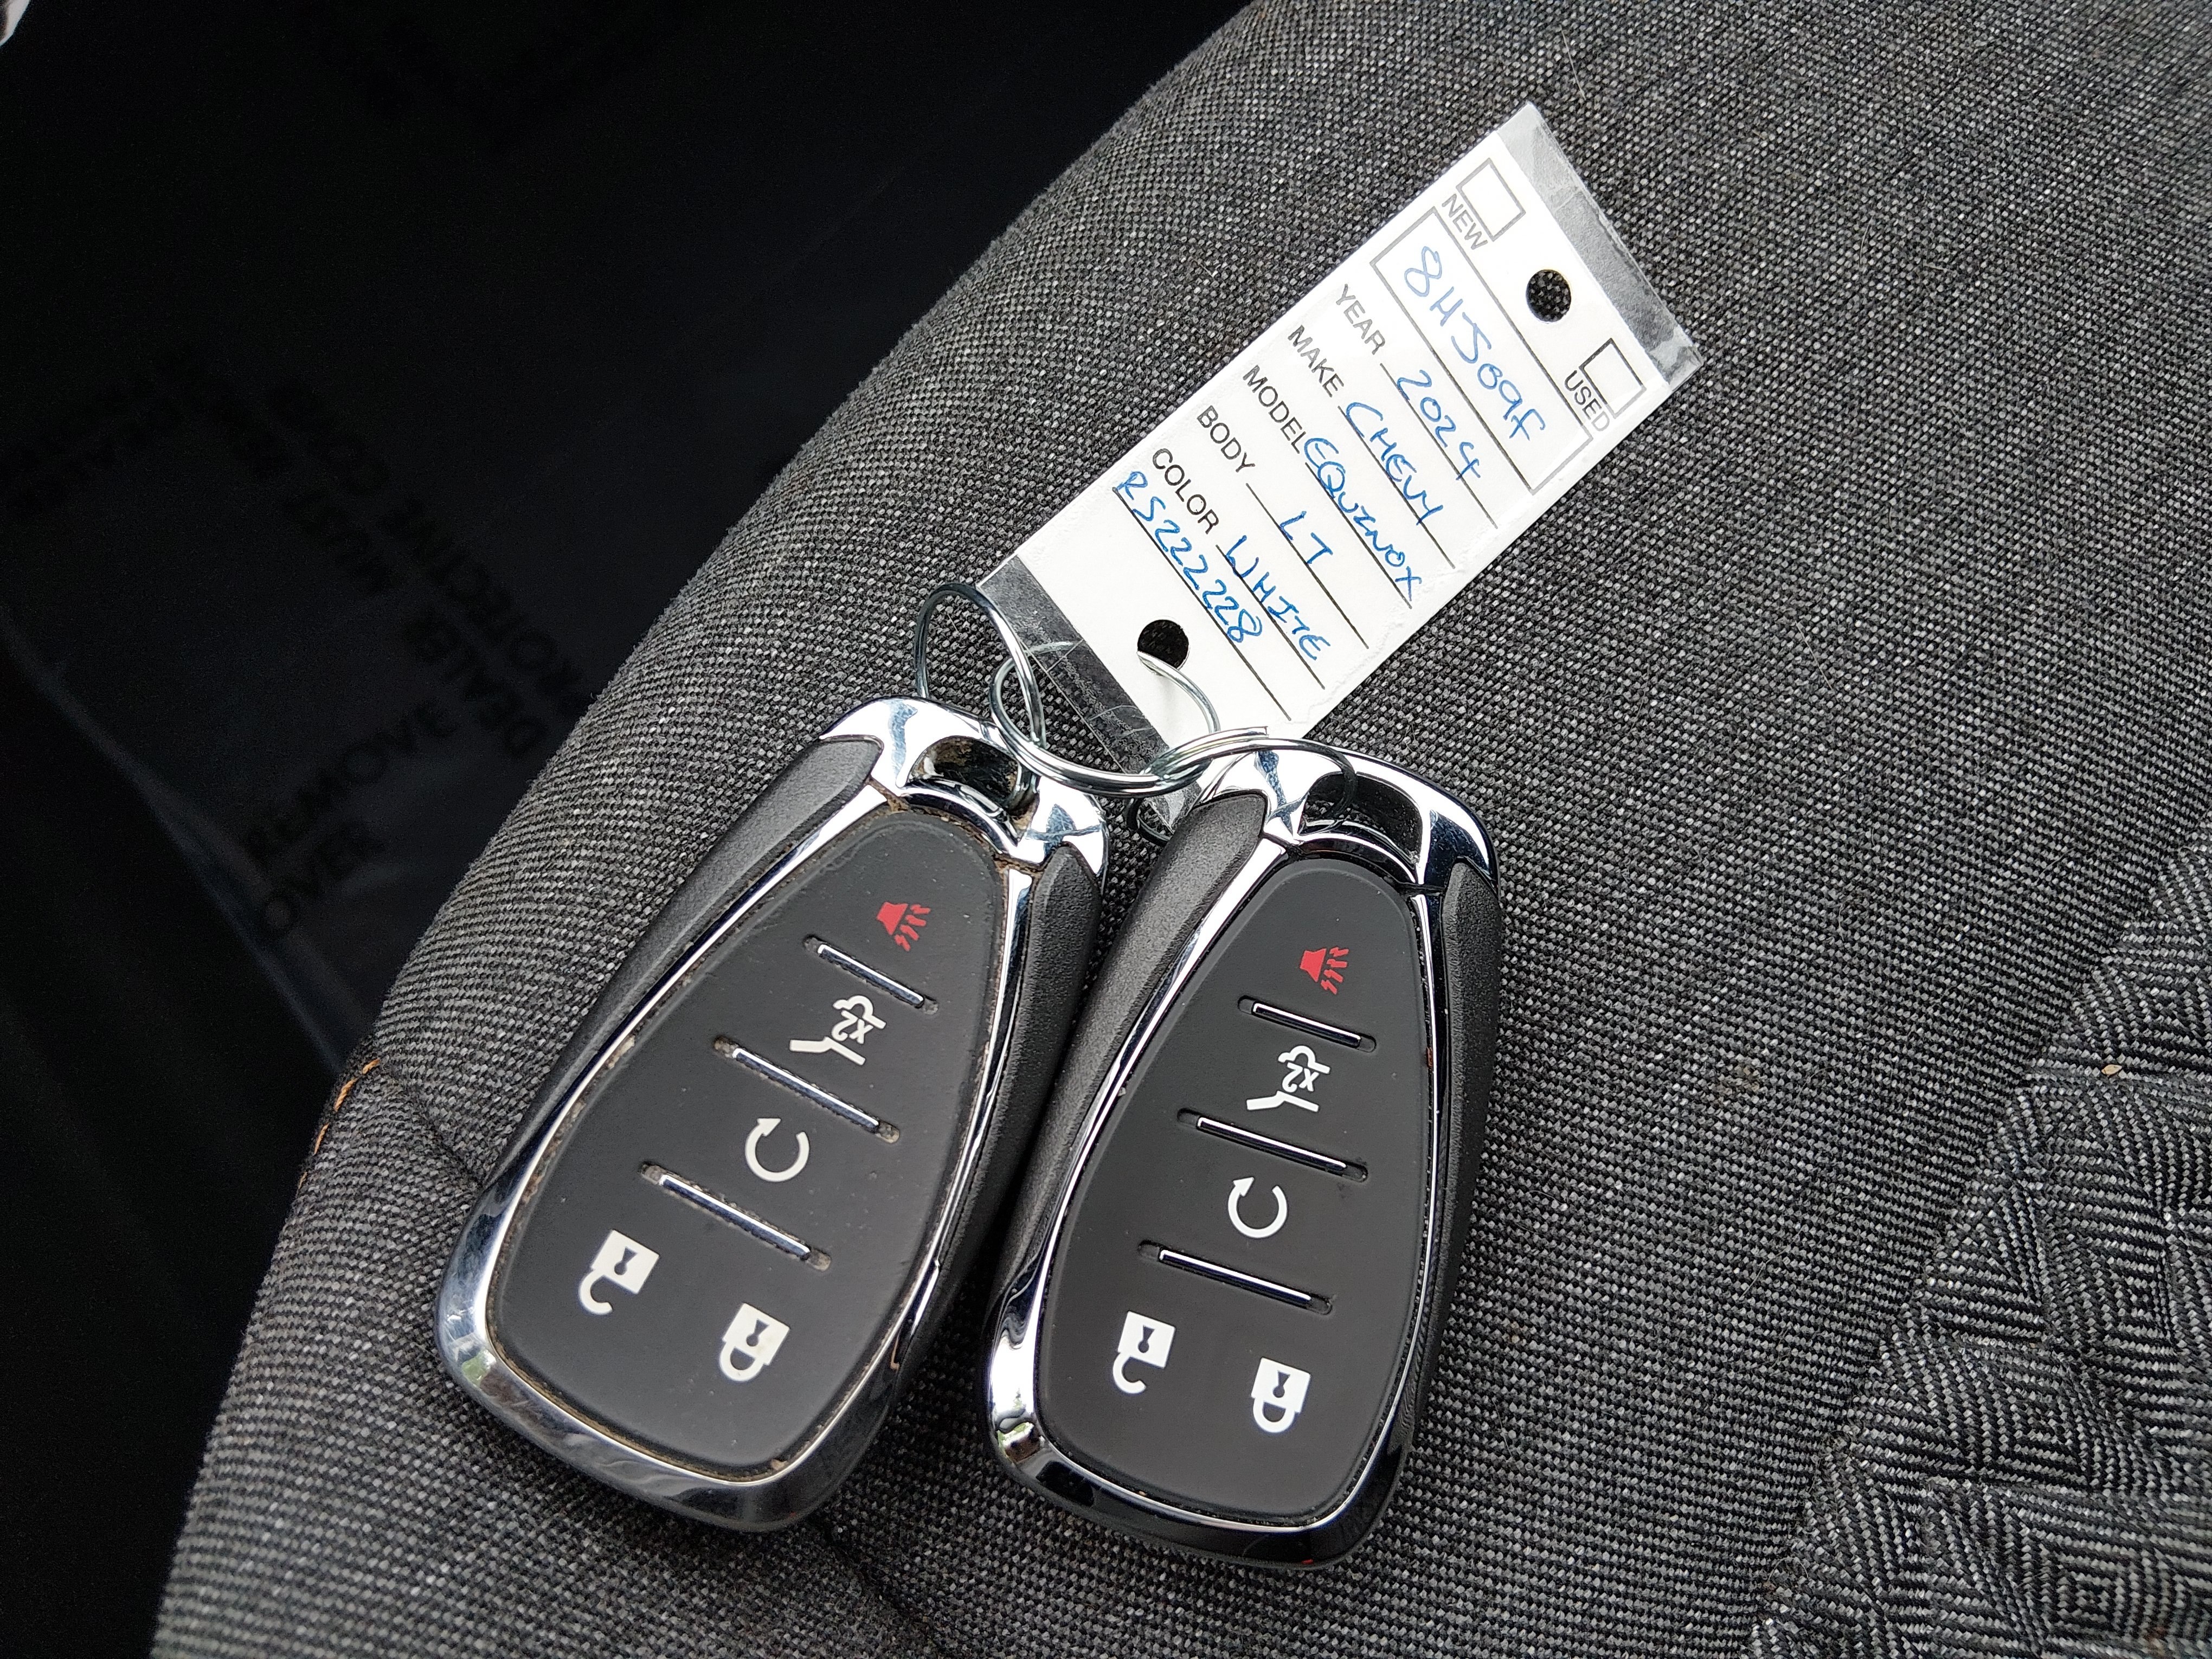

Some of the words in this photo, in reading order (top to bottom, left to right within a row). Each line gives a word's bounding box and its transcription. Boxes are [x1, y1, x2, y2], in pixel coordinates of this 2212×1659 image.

[1243, 364, 1307, 454] MODEL
[1336, 284, 1385, 355] YEAR
[1397, 369, 1481, 481] 2024
[1442, 194, 1488, 250] NEW
[1564, 370, 1610, 432] USED
[1196, 404, 1256, 473] BODY
[1279, 511, 1334, 565] LT
[1288, 325, 1345, 397] MAKE
[1346, 402, 1444, 526] CHEVY
[1152, 448, 1219, 535] COLOR
[1225, 535, 1331, 661] WHITE
[401, 606, 544, 756] DEALER
